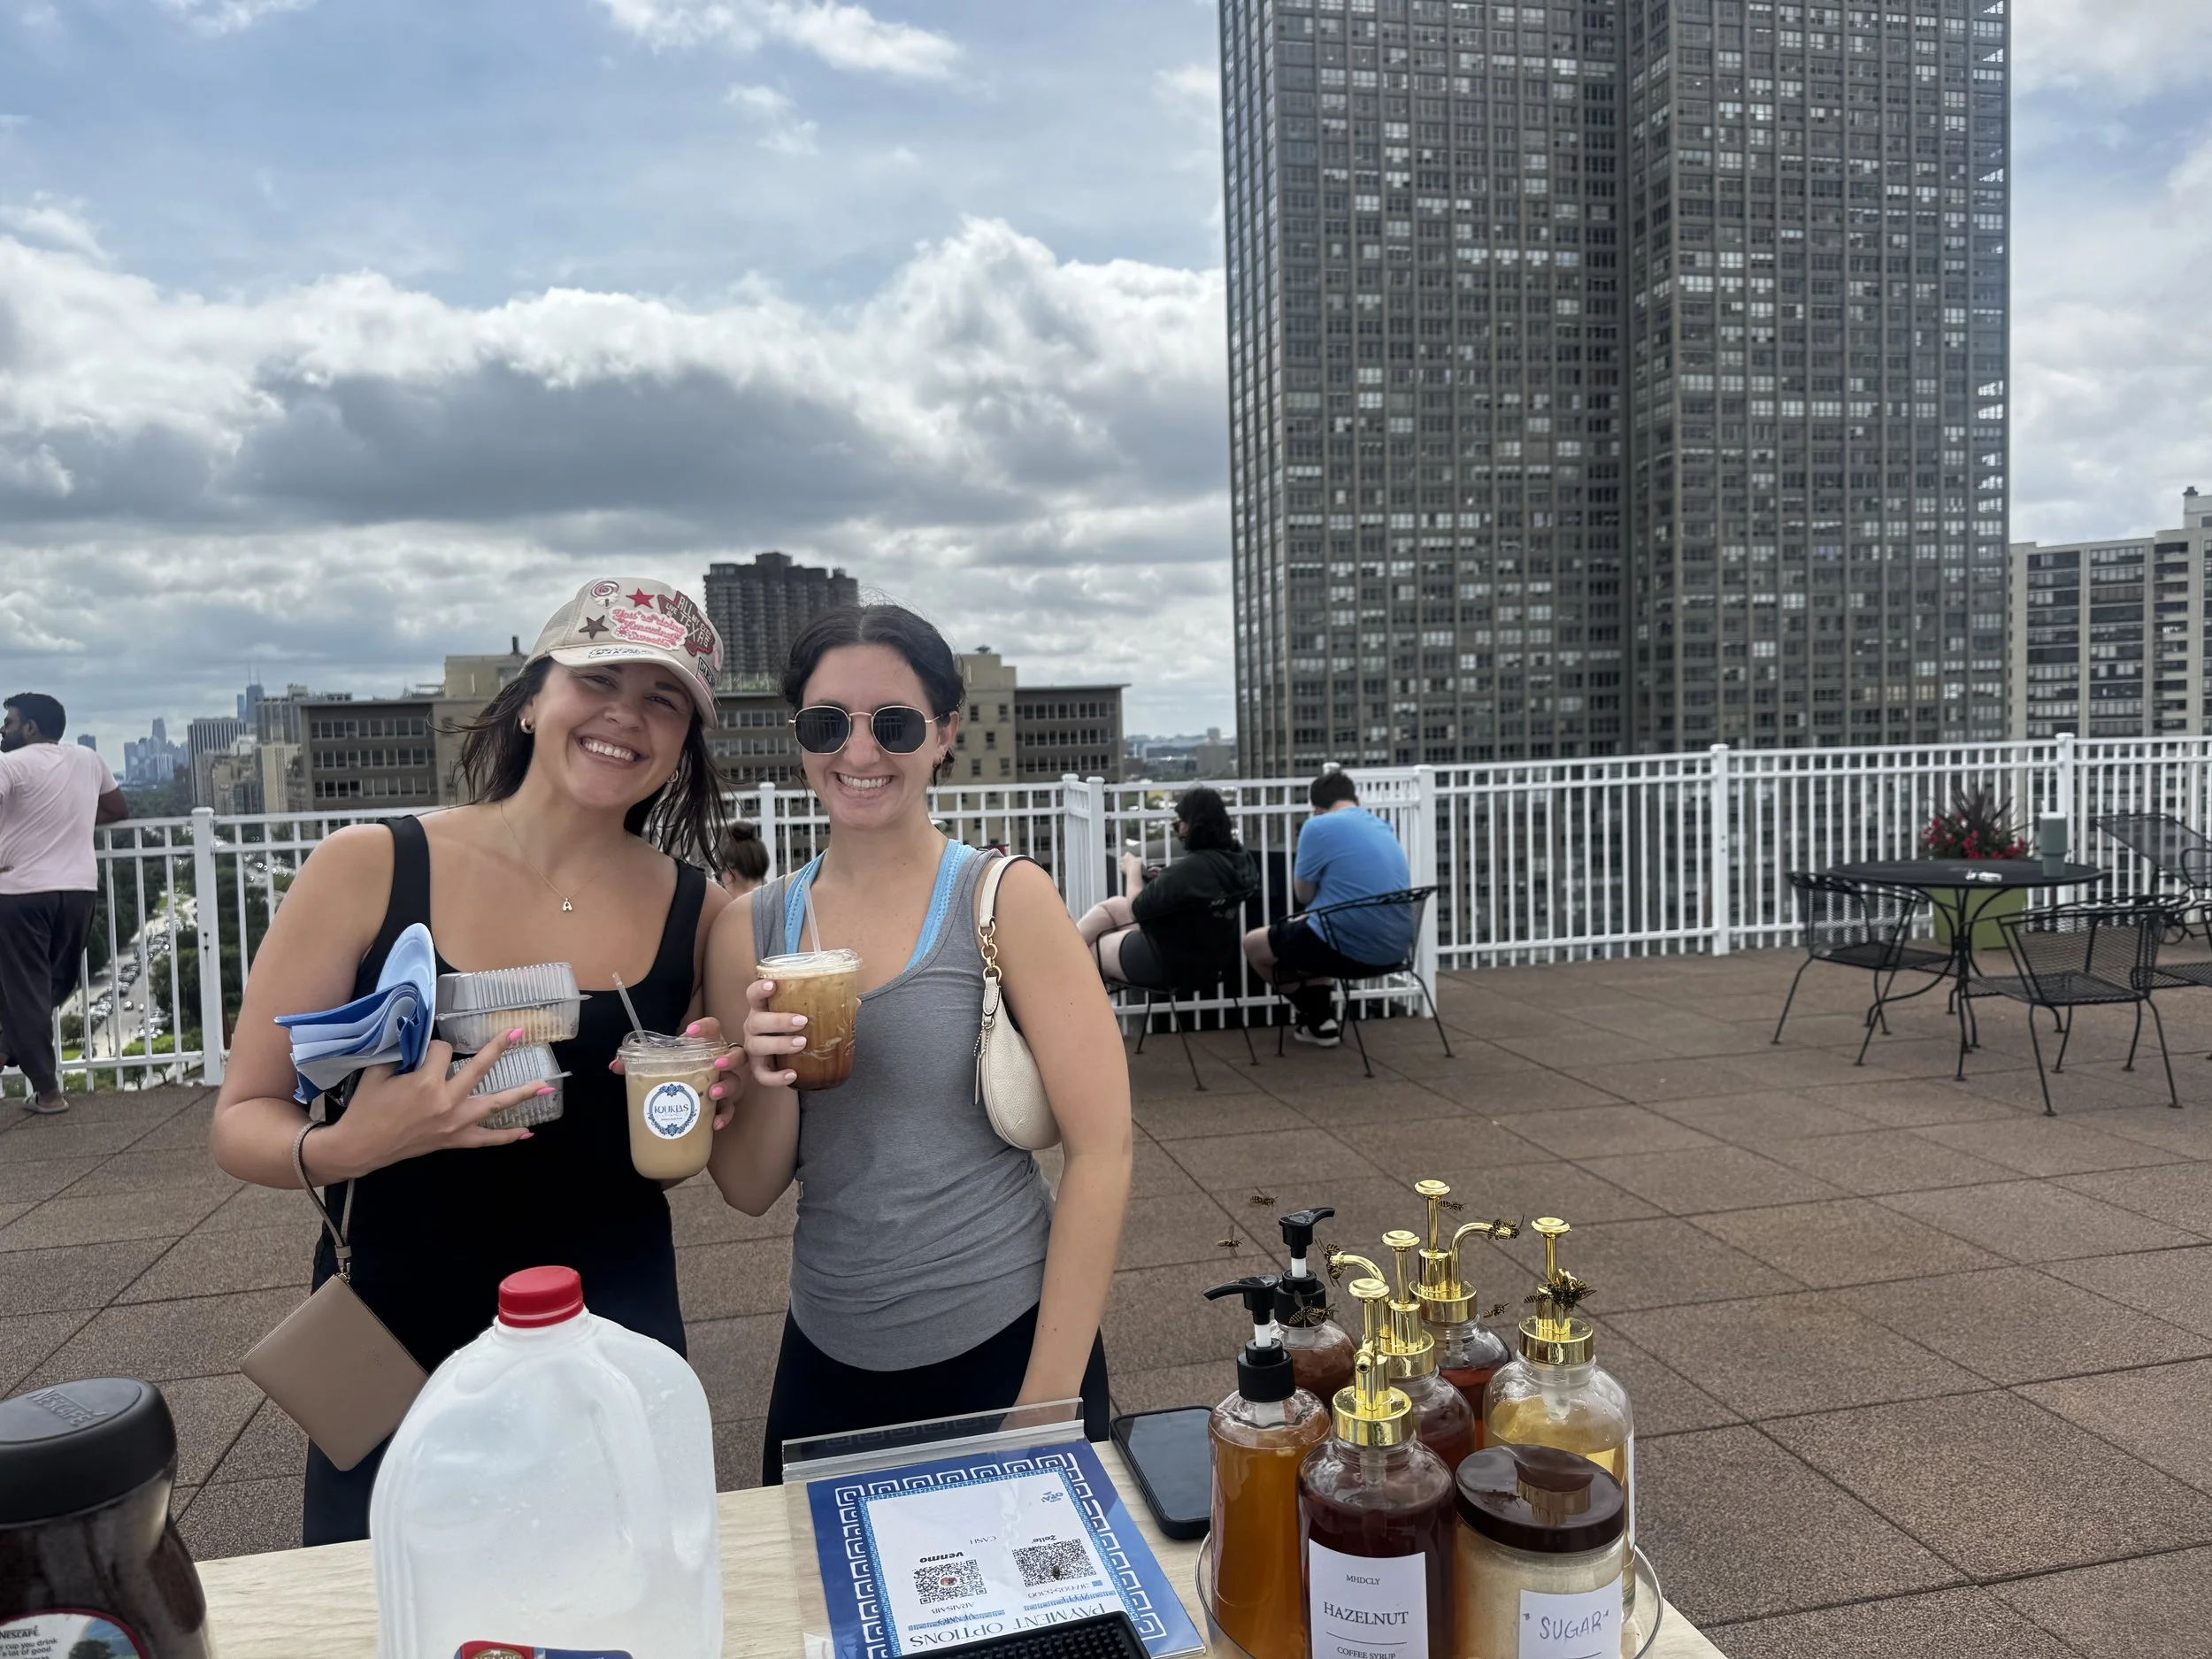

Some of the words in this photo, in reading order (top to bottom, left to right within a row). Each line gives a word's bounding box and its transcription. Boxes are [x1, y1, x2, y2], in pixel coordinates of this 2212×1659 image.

[677, 597, 692, 618] ALL
[919, 1551, 964, 1563] venmo
[1346, 1574, 1380, 1585] MHDCLY
[1013, 1602, 1105, 1630] PAYMENT
[1324, 1601, 1409, 1625] HAZELNUT
[910, 1622, 1003, 1647] OPTIONS
[36, 1638, 58, 1647] drink
[31, 1646, 51, 1655] good
[1337, 1646, 1367, 1659] COFFEE
